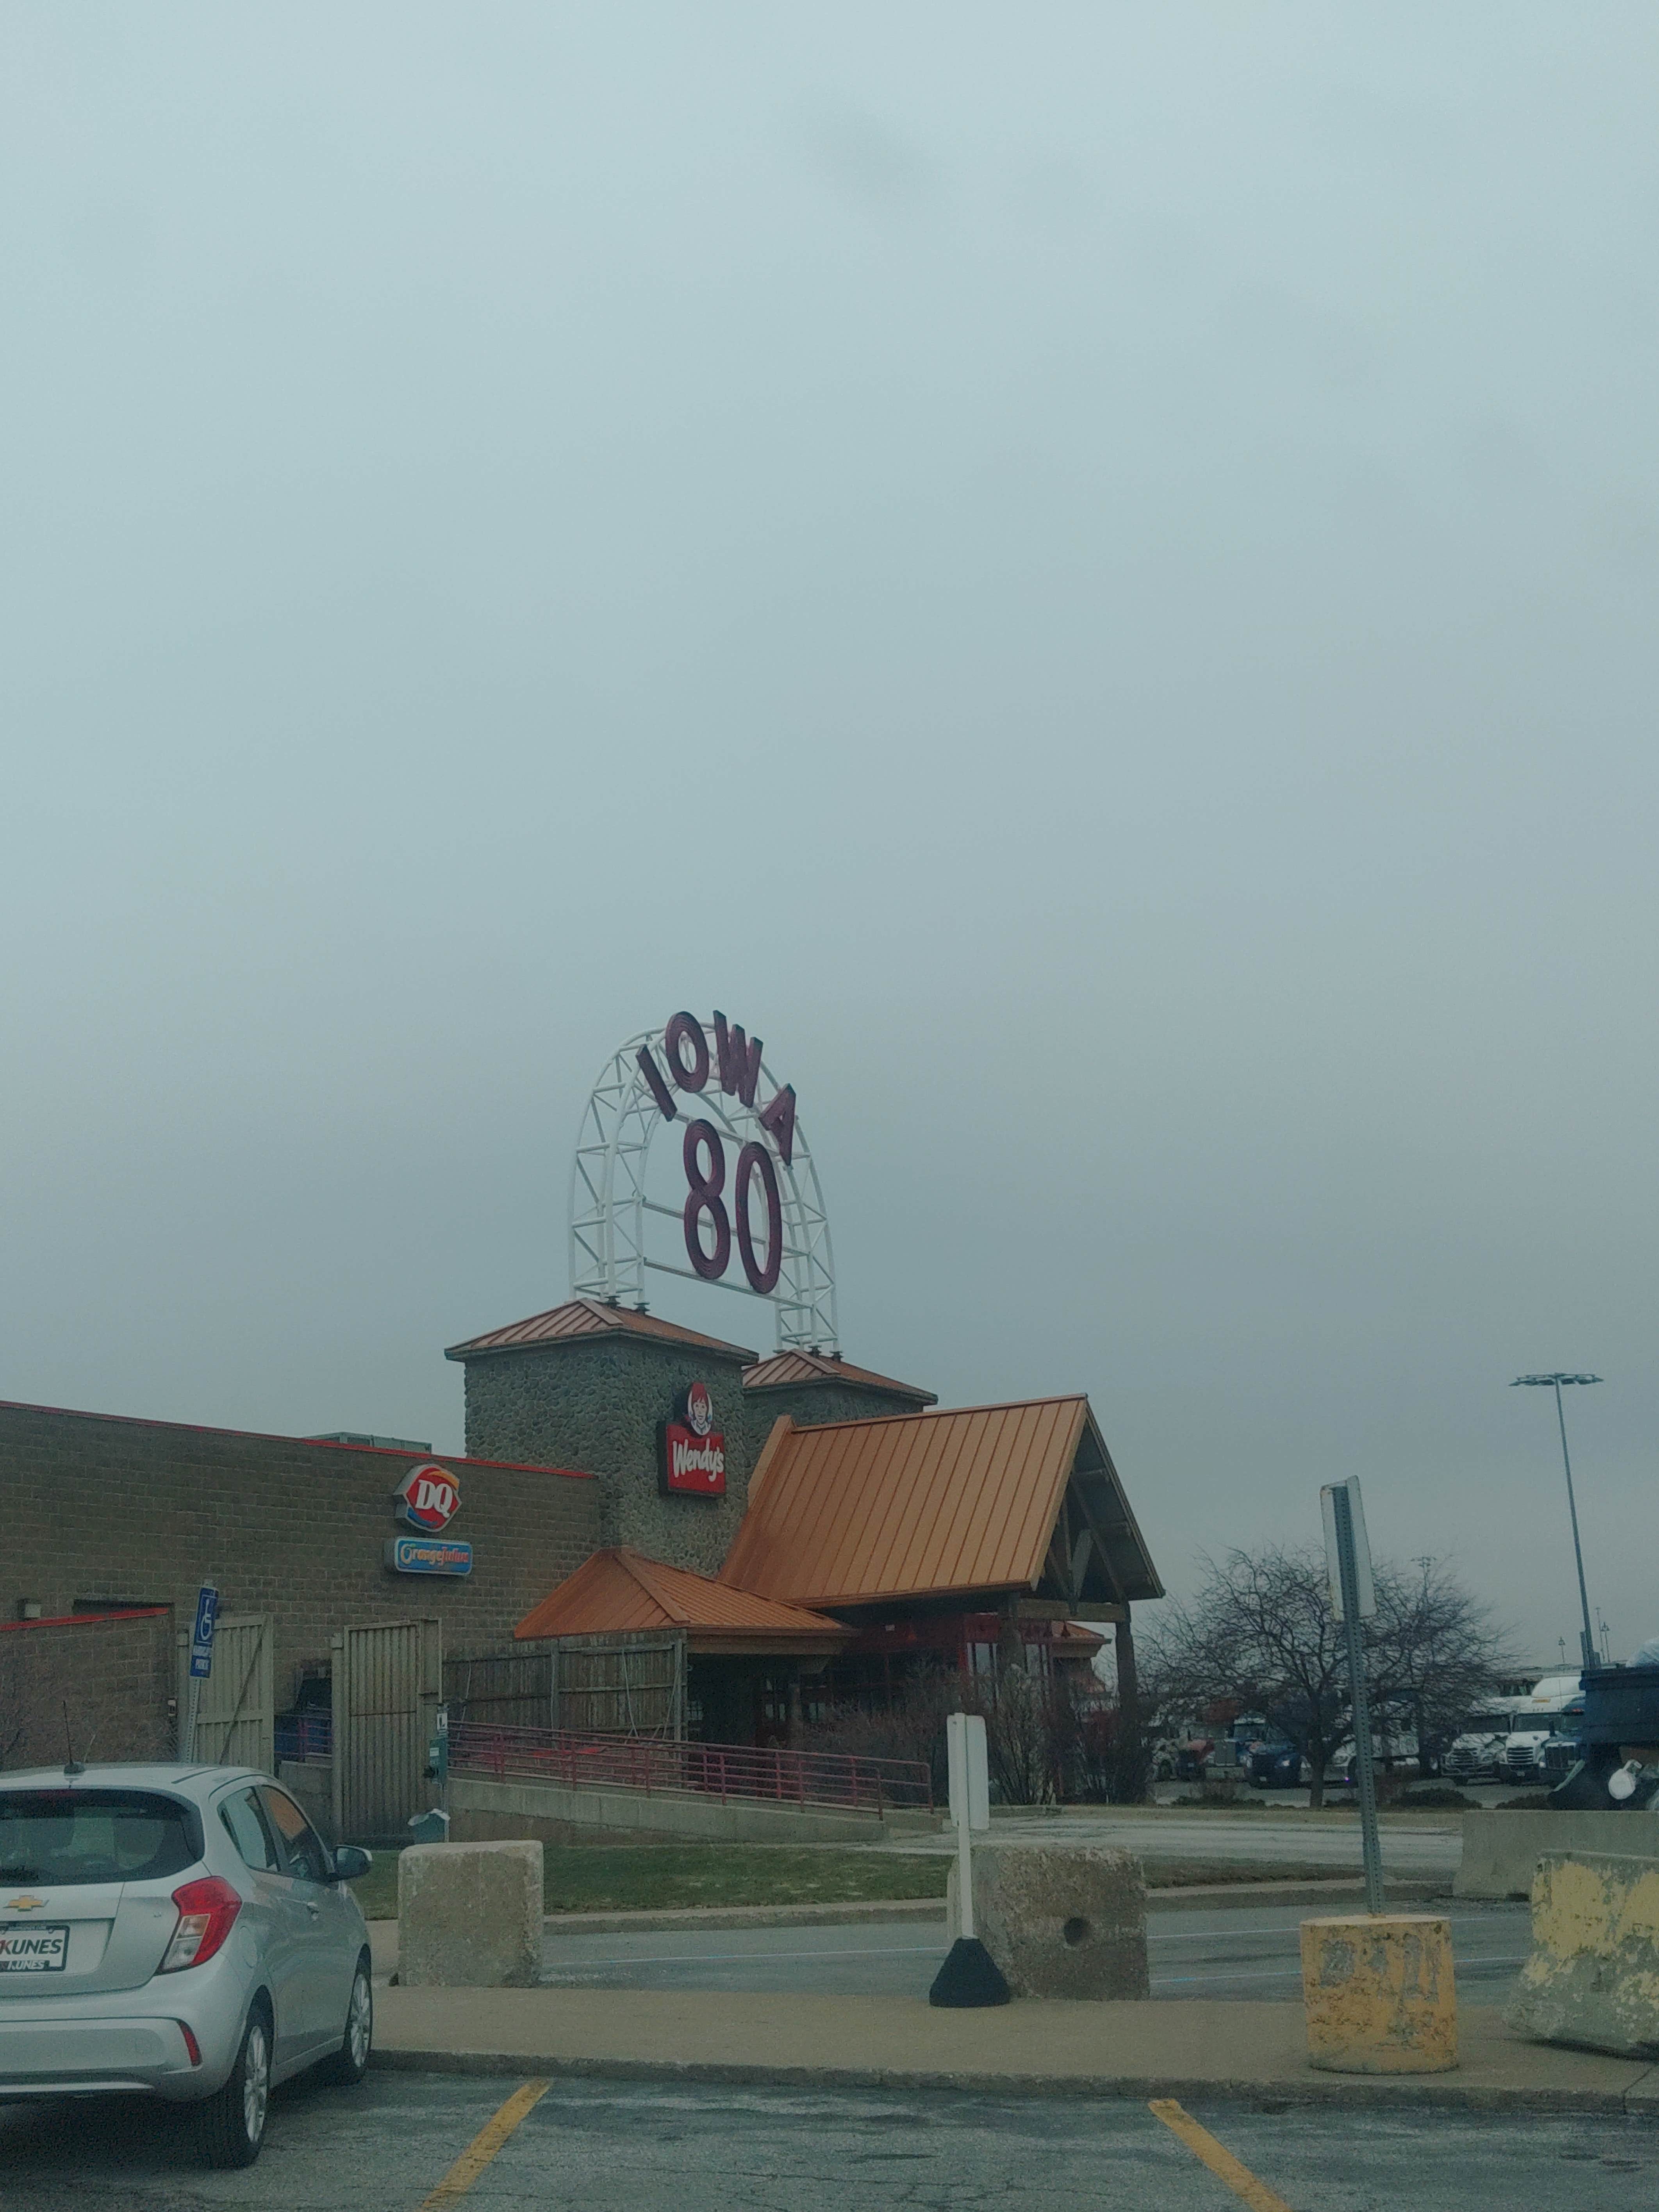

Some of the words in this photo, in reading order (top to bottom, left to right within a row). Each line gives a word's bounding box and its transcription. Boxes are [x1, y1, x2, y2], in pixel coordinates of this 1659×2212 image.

[635, 1010, 796, 1166] IOWA
[683, 1119, 782, 1293] 80
[673, 1438, 724, 1482] Wendy's
[415, 1480, 453, 1518] DQ
[0, 1939, 62, 1954] KUNES
